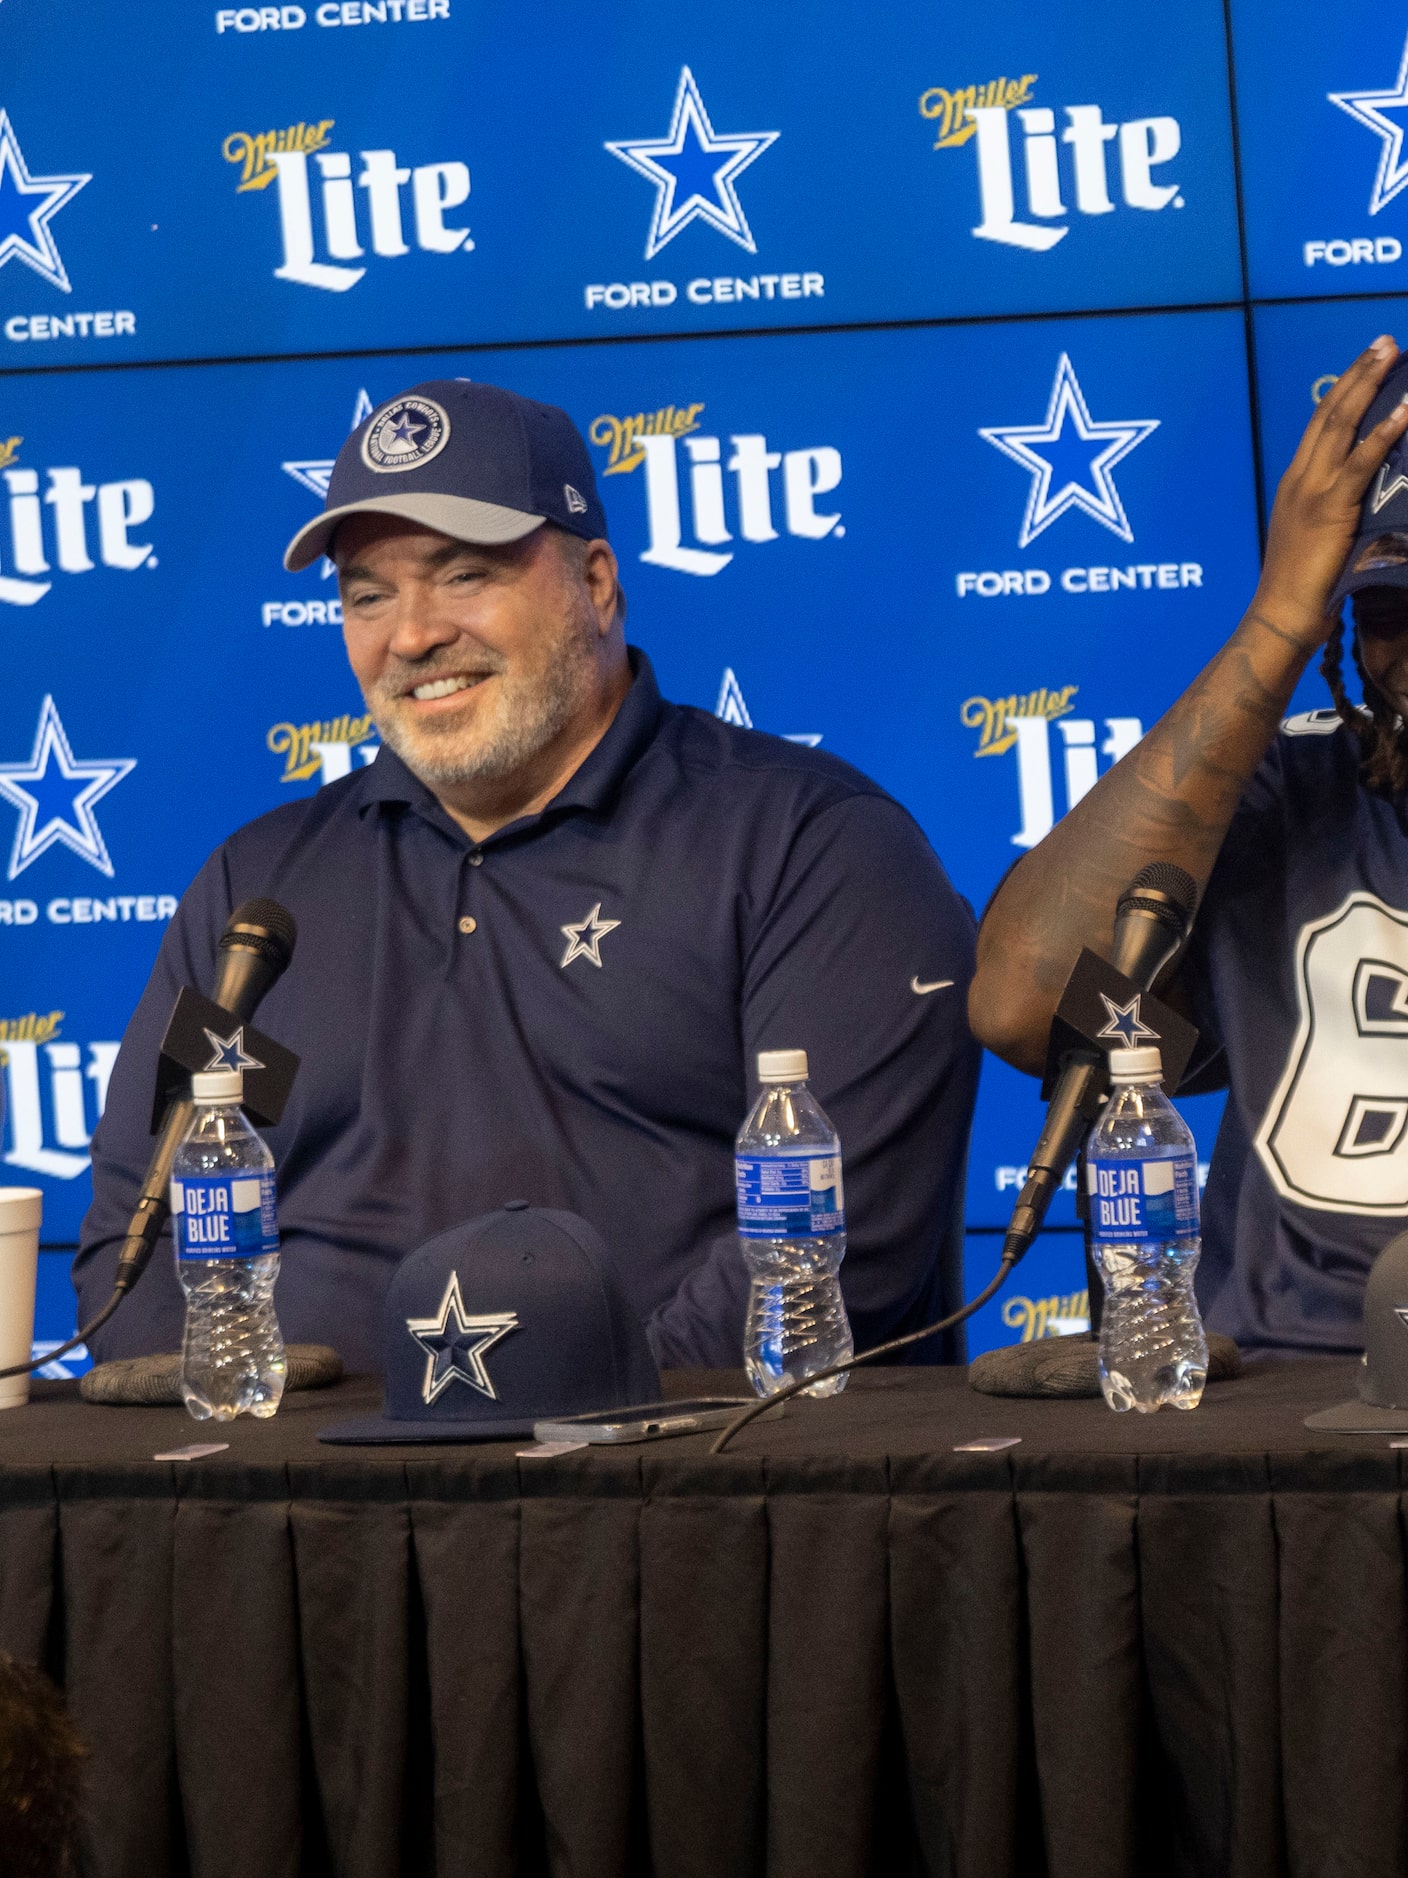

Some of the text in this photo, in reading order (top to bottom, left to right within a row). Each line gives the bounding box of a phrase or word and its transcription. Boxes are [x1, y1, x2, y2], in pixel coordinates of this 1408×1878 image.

[216, 0, 451, 34] FORD CENTER
[920, 74, 1038, 151] Miller
[223, 119, 335, 193] Miller
[1304, 237, 1402, 266] FORD
[585, 272, 824, 309] FORD CENTER
[5, 310, 136, 341] CENTER
[590, 403, 705, 476] Miller
[0, 467, 158, 606] ite
[956, 563, 1203, 598] FORD CENTER
[961, 685, 1079, 759] Miller
[47, 894, 178, 924] CENTER
[1098, 1169, 1140, 1198] DEJA
[186, 1187, 229, 1216] DEJA
[1100, 1197, 1142, 1226] BLUE
[187, 1214, 230, 1243] BLUE
